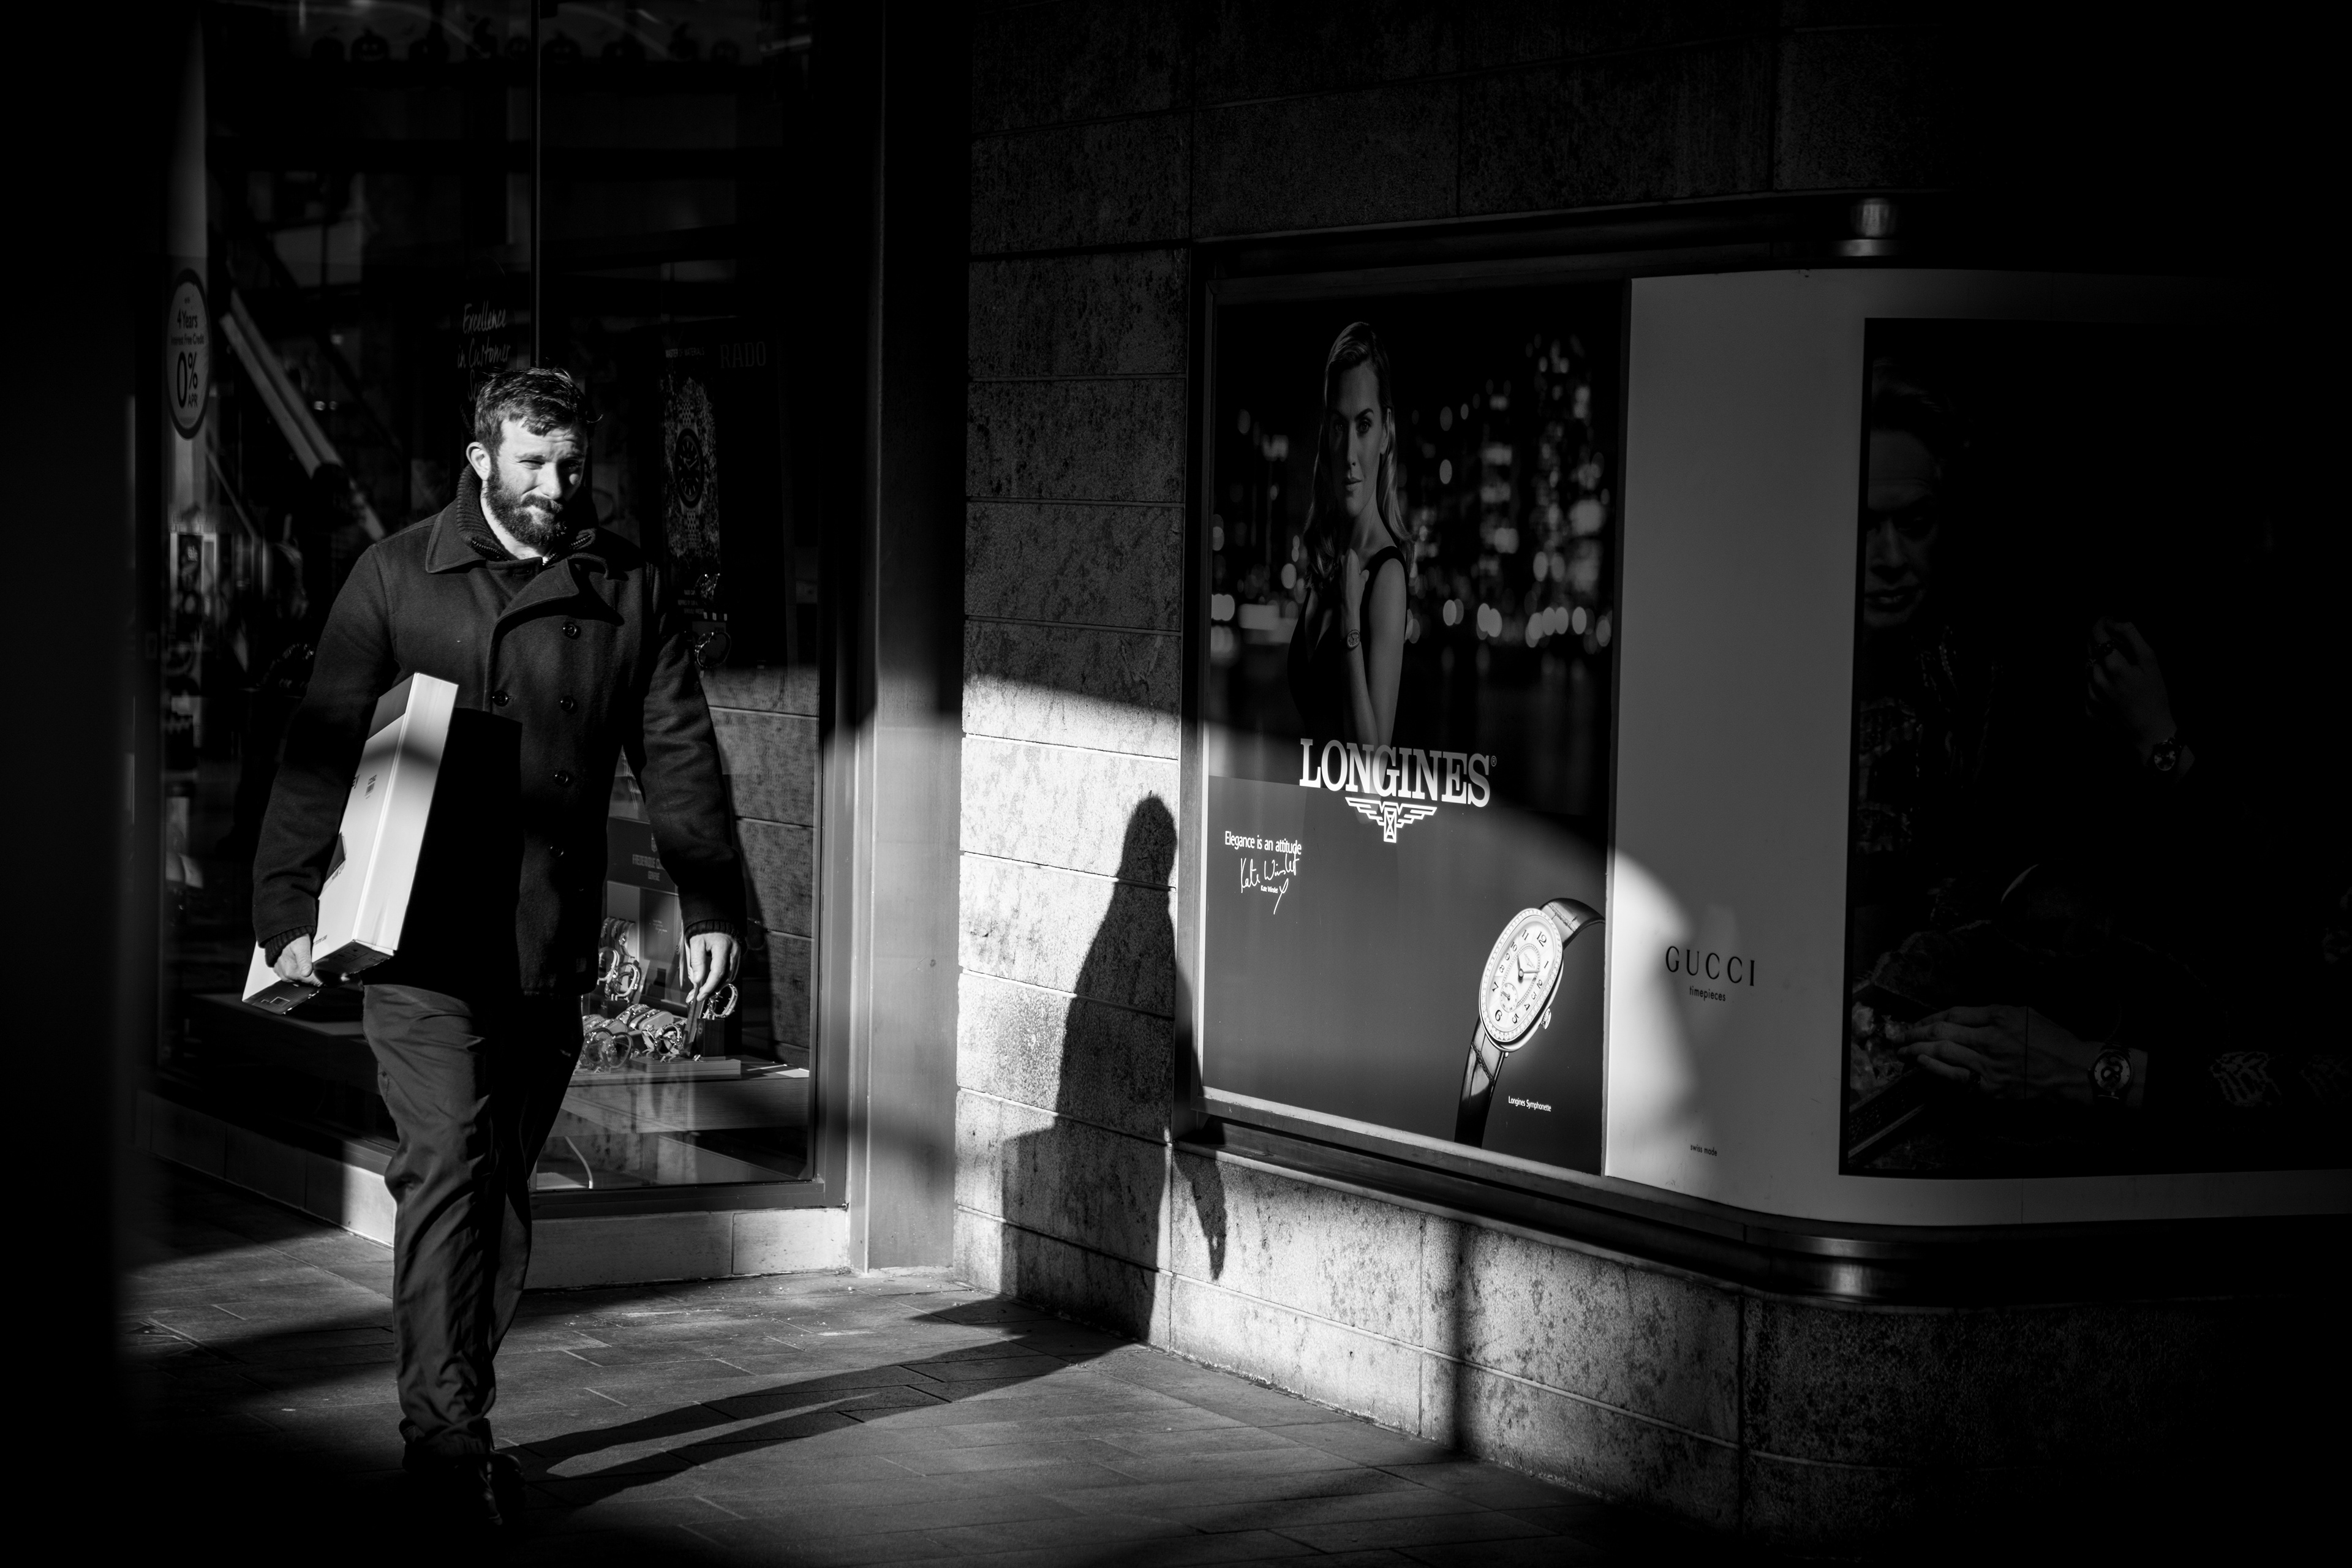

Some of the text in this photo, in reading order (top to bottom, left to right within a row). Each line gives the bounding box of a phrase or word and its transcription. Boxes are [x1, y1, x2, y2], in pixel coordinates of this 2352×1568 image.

[177, 309, 198, 329] 4 Years
[463, 300, 506, 334] Excellence
[458, 336, 511, 369] in Customer
[684, 347, 704, 356] MATERIALS
[720, 341, 766, 369] RADO
[177, 352, 198, 408] 0%
[188, 393, 198, 409] APR
[1225, 831, 1302, 855] Elegance is an attitude
[1521, 929, 1529, 941] 11
[1536, 931, 1547, 947] 12
[1510, 941, 1518, 952] 10
[1504, 952, 1510, 961] 9
[1499, 965, 1505, 973] 8
[1544, 960, 1549, 969] 1
[1665, 946, 1755, 987] GUCCI
[1491, 981, 1499, 992] 7
[1536, 979, 1543, 989] 2
[1531, 991, 1537, 1000] 3
[1689, 986, 1726, 1002] timepieces
[1524, 1003, 1531, 1011] 4
[1494, 1009, 1502, 1022] 6
[1512, 1013, 1520, 1024] 5
[1509, 1096, 1551, 1112] Longines Symphonette
[1691, 1144, 1703, 1153] swiss
